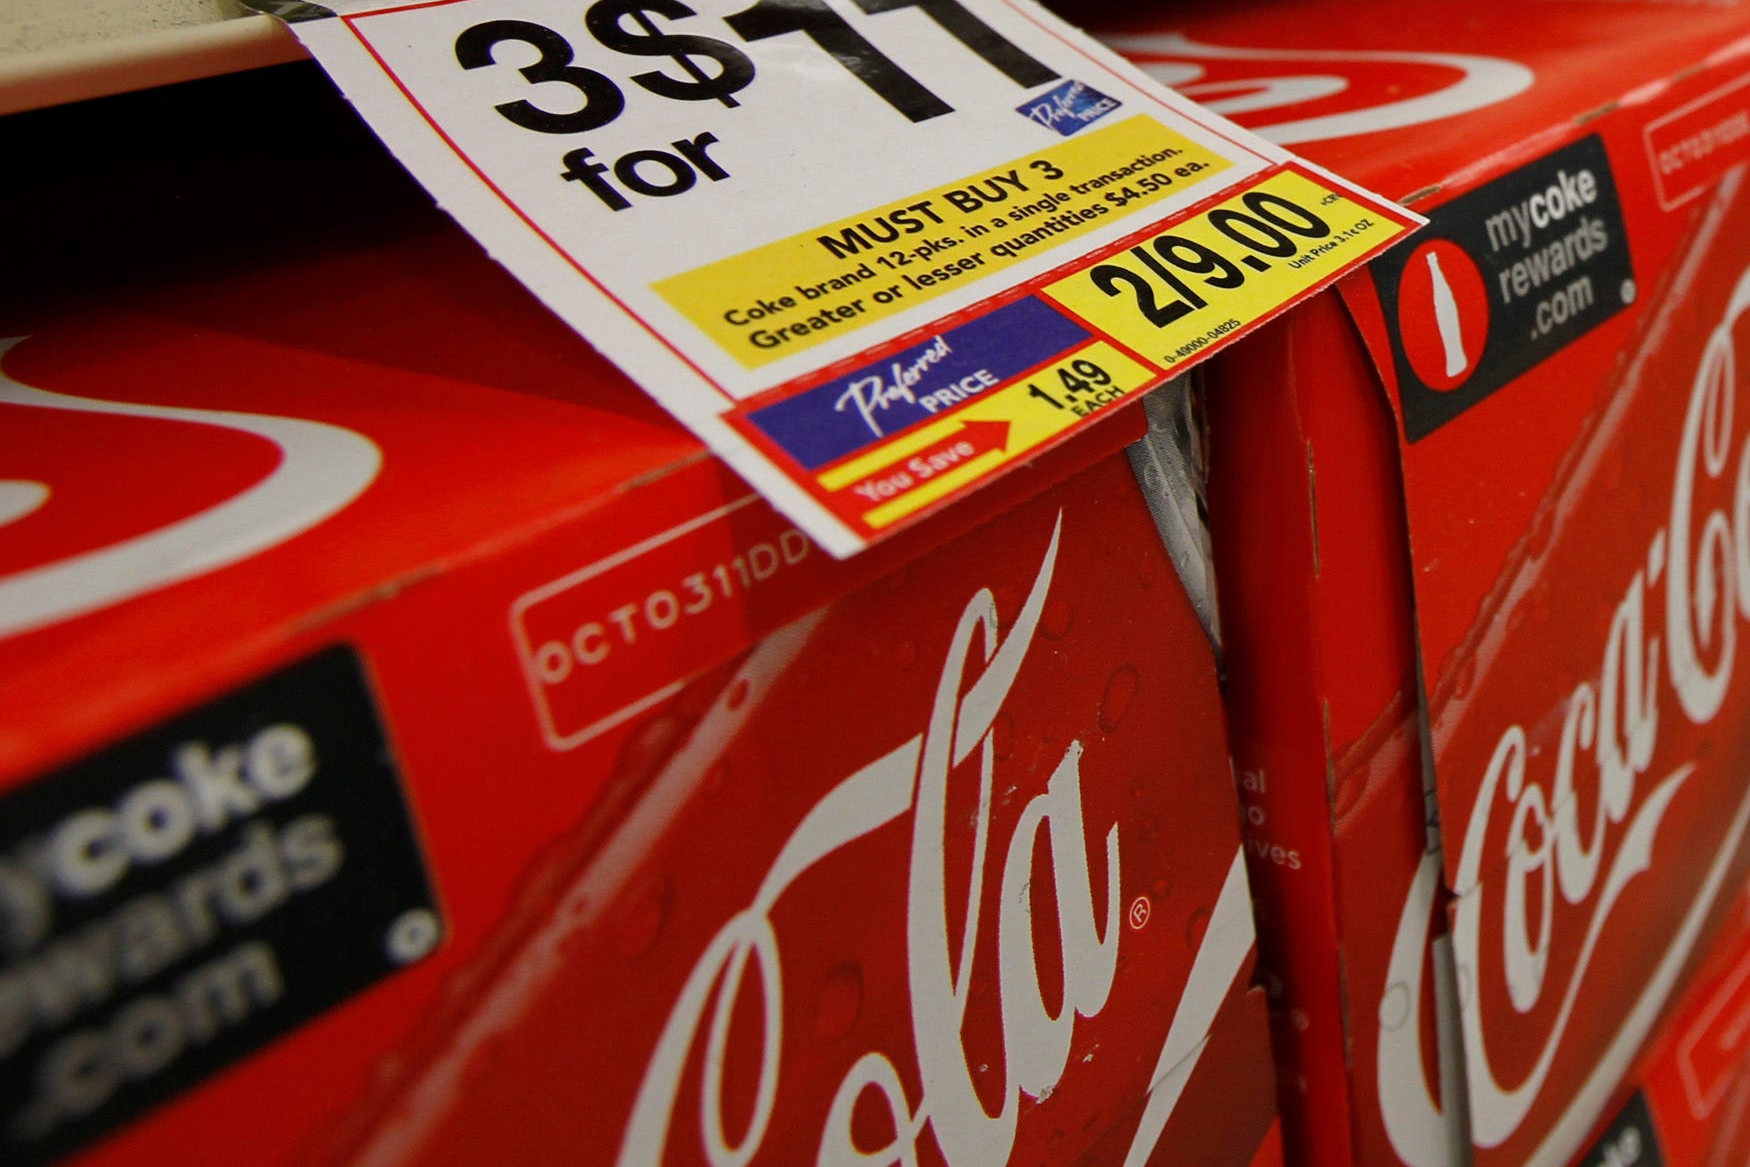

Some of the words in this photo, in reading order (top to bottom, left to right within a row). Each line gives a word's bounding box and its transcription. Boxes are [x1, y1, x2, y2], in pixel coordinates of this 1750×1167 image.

[560, 131, 732, 212] for
[817, 200, 946, 261] MUST
[942, 167, 1033, 216] BUY
[1029, 158, 1066, 182] 3
[723, 291, 797, 328] Coke
[795, 261, 877, 301] brand
[876, 234, 967, 274] 12-pks.
[964, 220, 991, 238] in
[990, 213, 1007, 230] a
[1006, 188, 1072, 224] single
[1069, 145, 1185, 198] transaction.
[747, 307, 868, 352] Greater
[872, 283, 905, 306] or
[912, 250, 986, 292] lesser
[990, 202, 1110, 260] quantities
[1104, 171, 1174, 210] $4.50
[1173, 160, 1211, 179] ea.
[1089, 191, 1331, 329] 2/9.00
[1288, 254, 1316, 270] Unit
[1310, 241, 1338, 257] Price
[1354, 218, 1375, 231] OZ
[1498, 214, 1609, 306] rewards
[1530, 274, 1595, 341] .com
[918, 368, 1000, 414] PRICE
[1029, 358, 1113, 412] 1.49
[853, 475, 911, 504] You
[908, 439, 976, 478] Save
